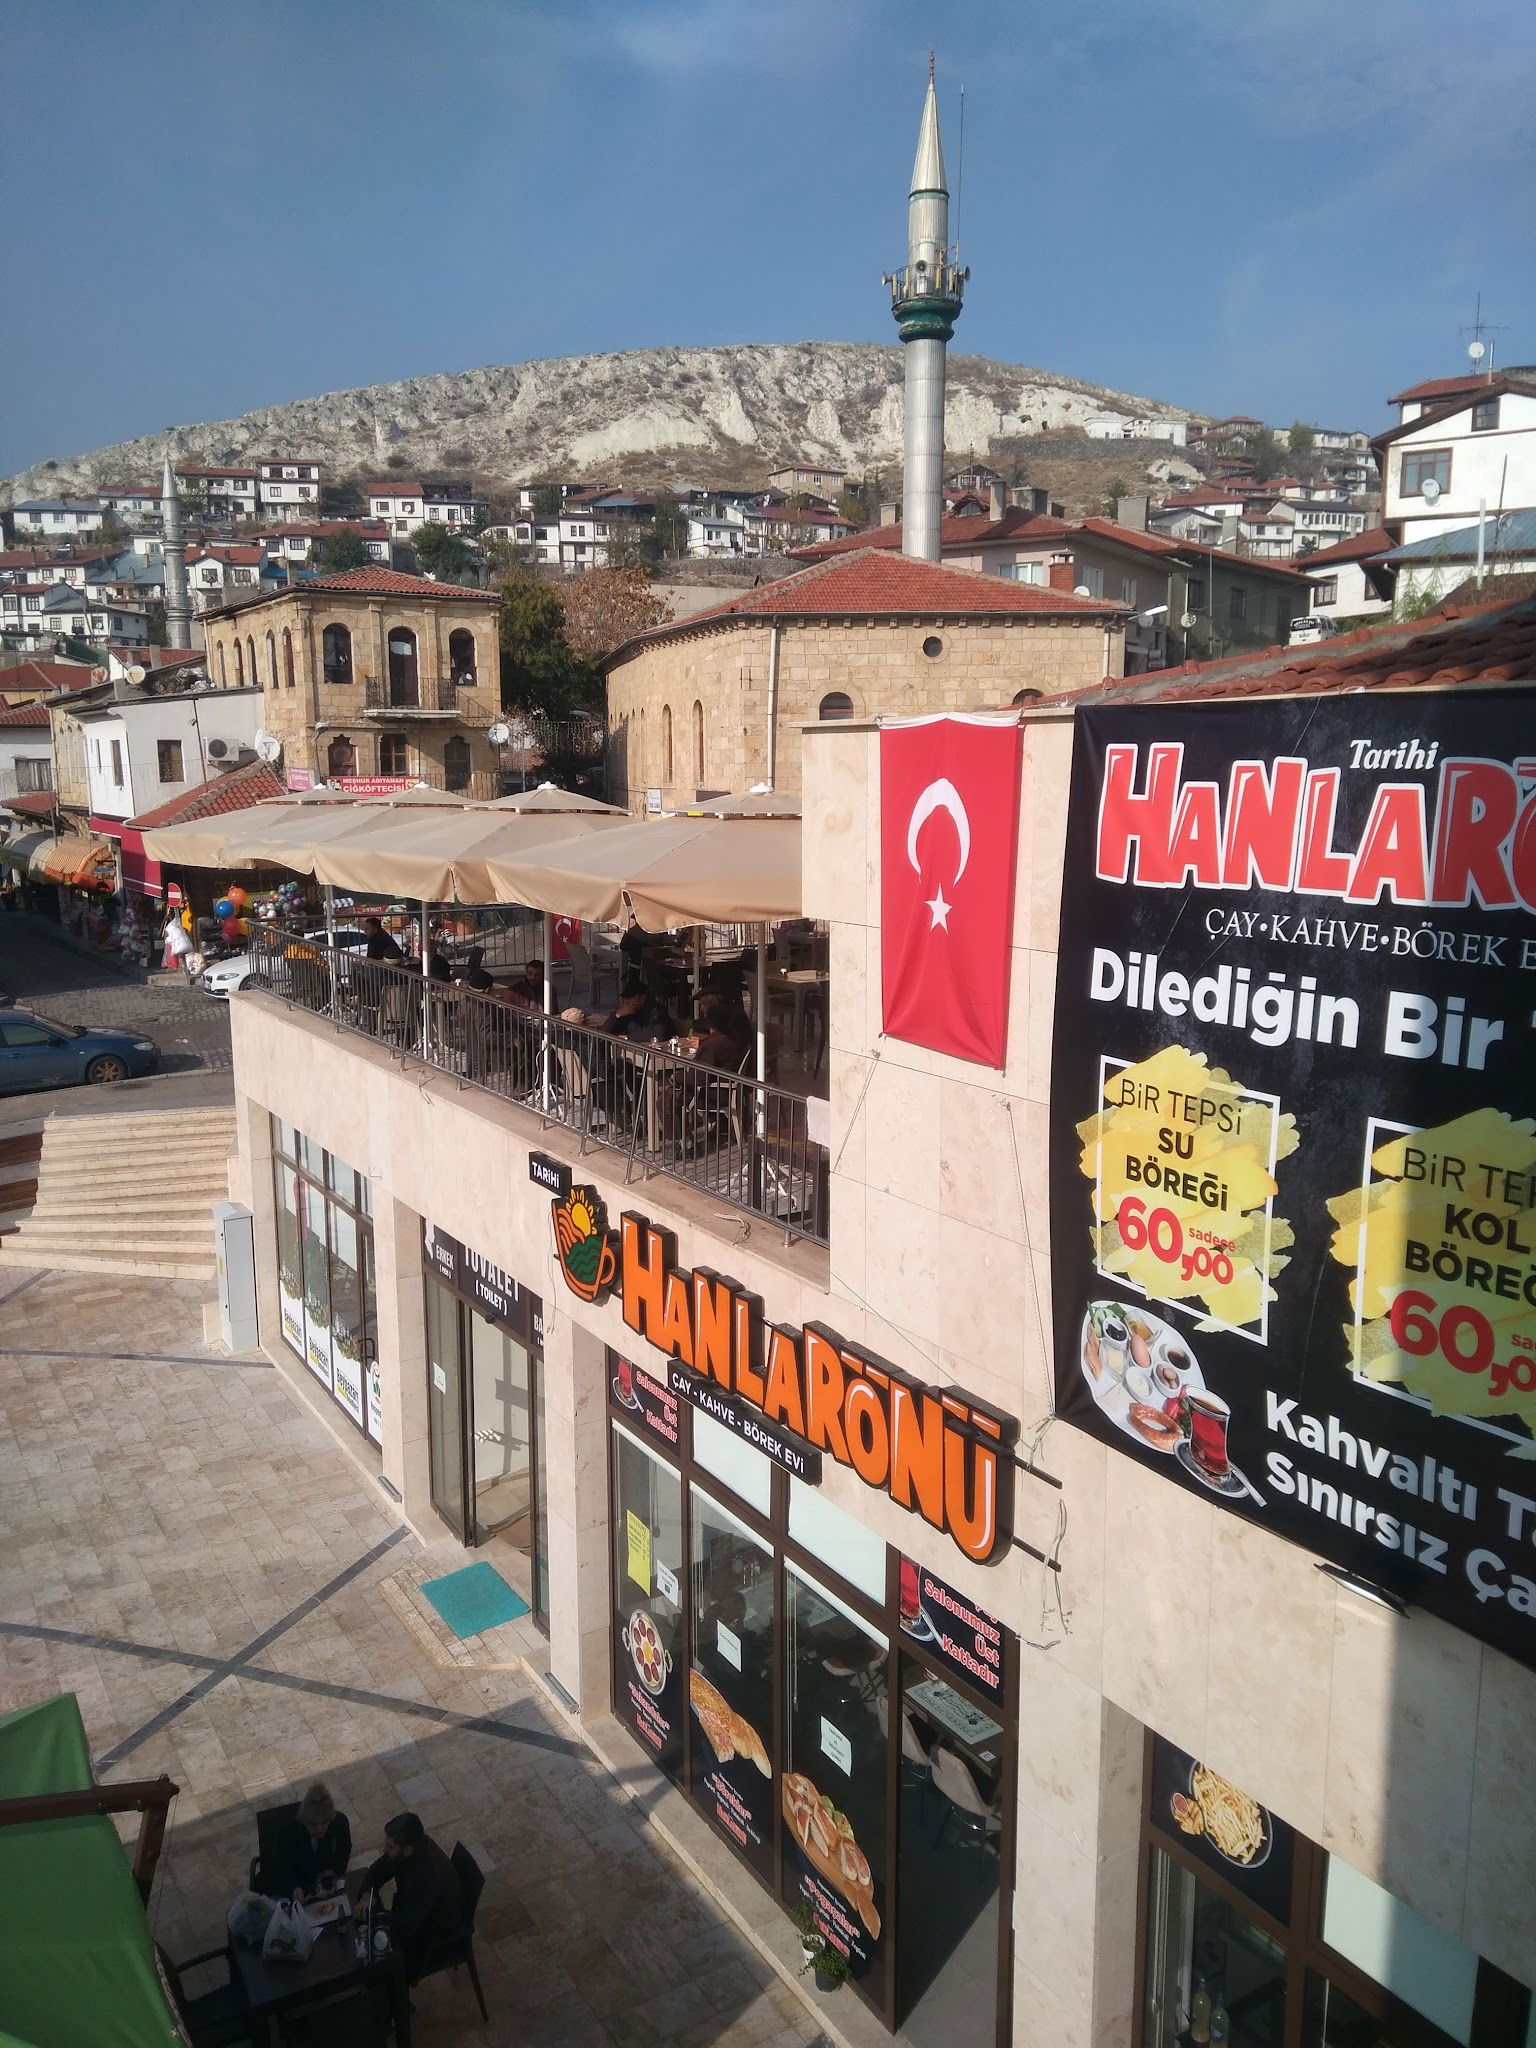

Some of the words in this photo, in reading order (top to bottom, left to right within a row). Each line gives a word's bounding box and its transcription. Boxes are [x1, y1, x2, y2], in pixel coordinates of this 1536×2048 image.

[1350, 738, 1440, 770] Tarihi
[1090, 947, 1360, 1049] Dilediğin
[1384, 990, 1504, 1071] Bir
[1157, 1127, 1194, 1160] SU
[1188, 1226, 1237, 1252] sadece
[1444, 1203, 1531, 1255] KOL
[619, 1208, 1016, 1568] HANLARÖNÜ
[636, 1370, 678, 1411] Salonumuz
[664, 1404, 678, 1428] Üst
[672, 1373, 692, 1396] ÇAY
[700, 1390, 735, 1426] KAHVE
[744, 1420, 782, 1459] BÖREK
[1266, 1389, 1477, 1522] Kahvaltı
[1267, 1451, 1447, 1577] Sınırsız
[924, 1578, 1000, 1646] Salonumuz
[942, 1633, 1000, 1690] Kattadır
[975, 1633, 1000, 1668] Üst
